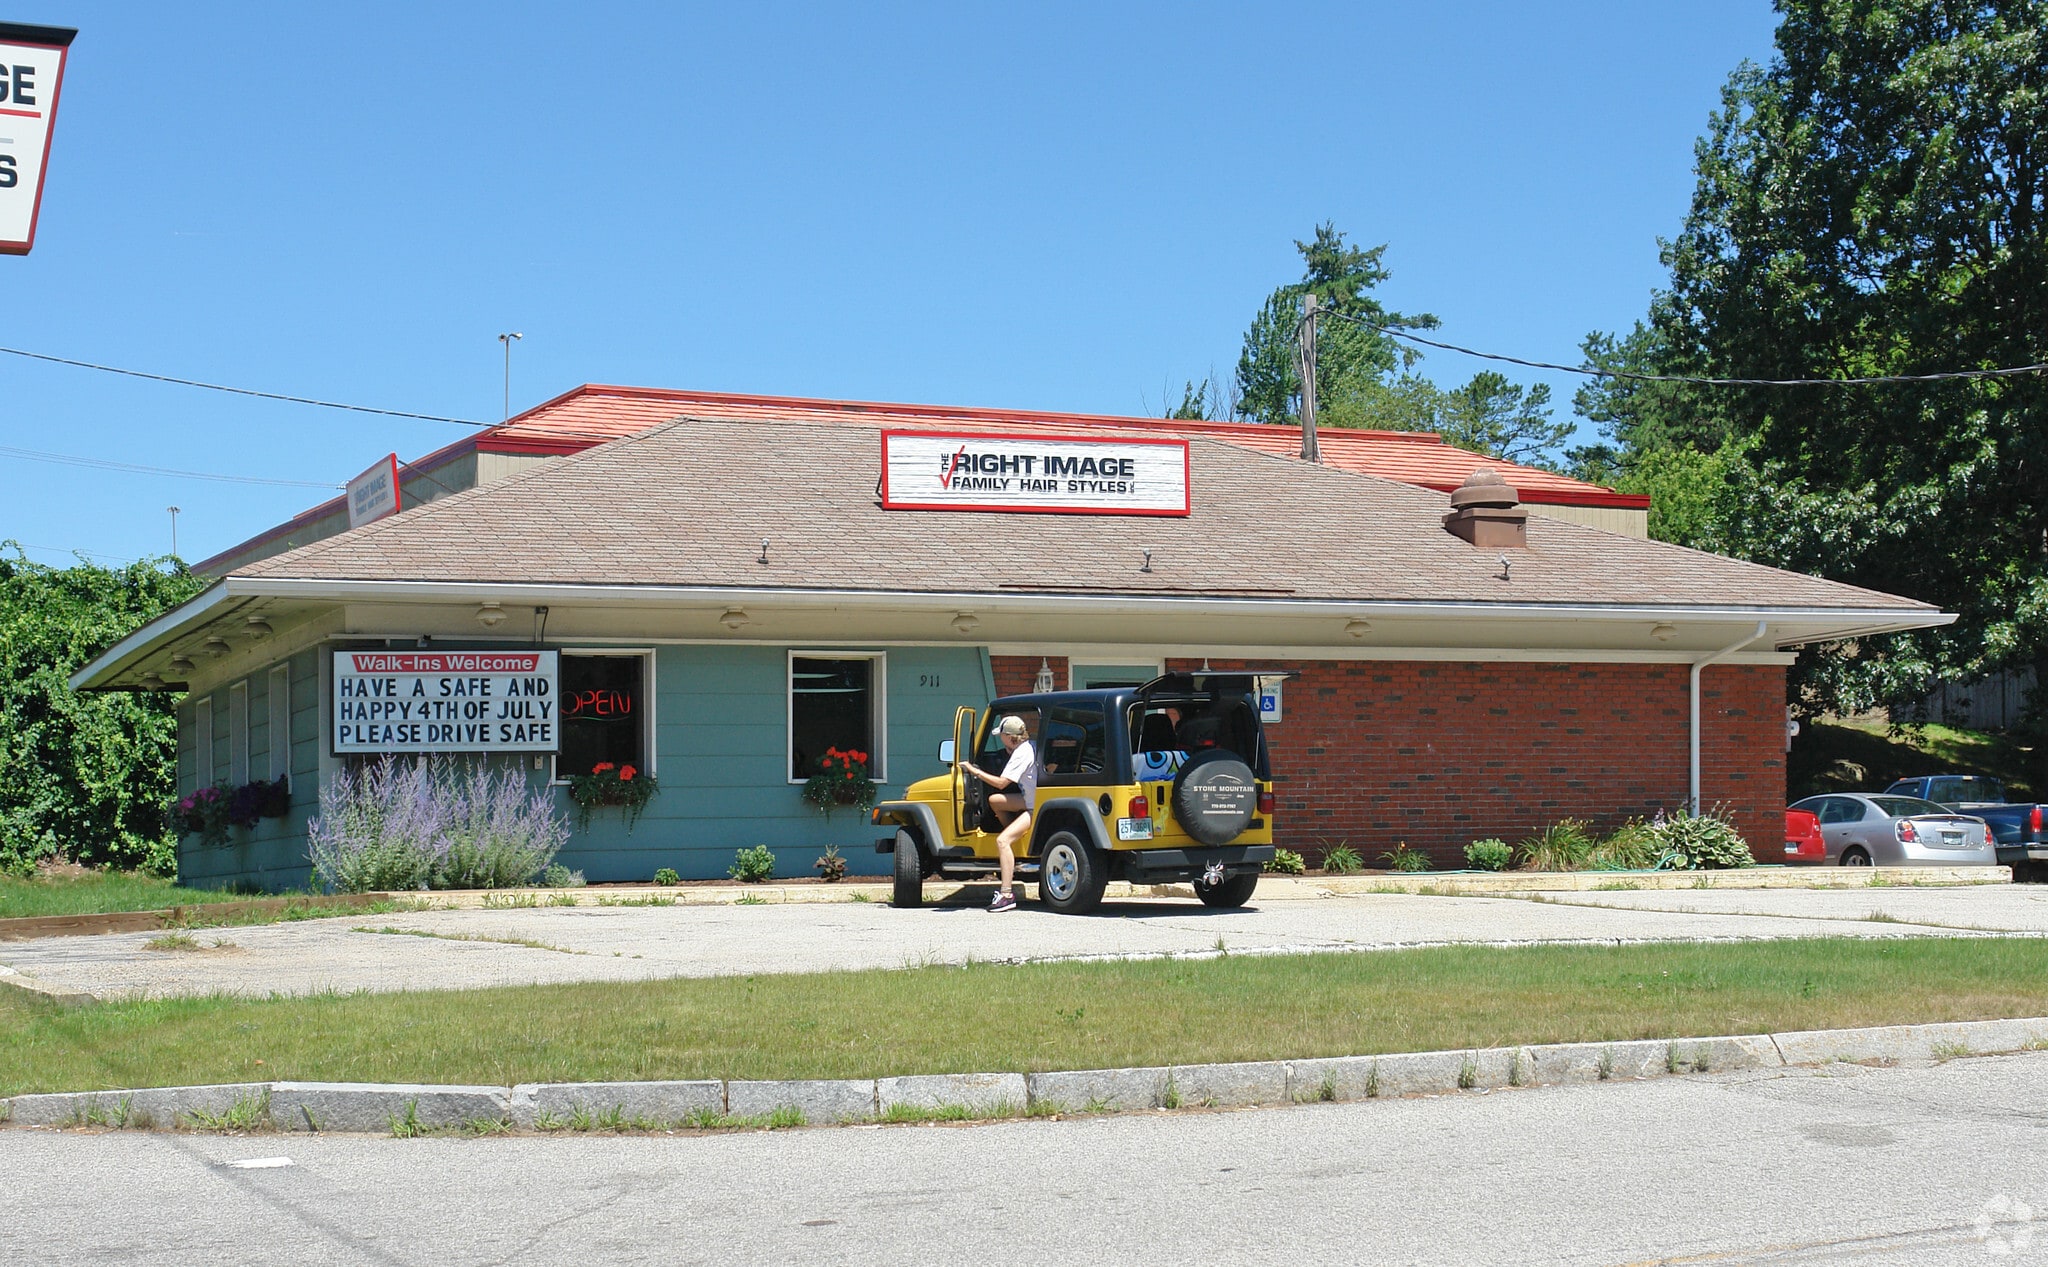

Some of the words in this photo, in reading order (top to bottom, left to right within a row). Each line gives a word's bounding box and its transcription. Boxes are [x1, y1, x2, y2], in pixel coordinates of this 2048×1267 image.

[941, 453, 949, 472] THE
[952, 453, 1037, 475] RIGHT
[1044, 456, 1135, 477] IMAGE
[952, 476, 1010, 490] FAMILY
[1020, 478, 1058, 491] HAIR
[1068, 479, 1127, 493] STYLES
[357, 656, 442, 671] Walk-Ins
[445, 656, 534, 671] Welcome
[341, 678, 397, 697] HAVE
[412, 678, 425, 697] A
[439, 678, 492, 697] SAFE
[507, 678, 550, 697] AND
[920, 674, 940, 688] 911
[340, 701, 412, 720] HAPPY
[417, 701, 459, 720] 4TH
[463, 701, 490, 720] OF
[497, 701, 553, 720] JULY
[560, 690, 631, 714] OPEN
[340, 724, 421, 744] PLEASE
[428, 724, 490, 743] DRIVE
[499, 723, 552, 743] SAFE
